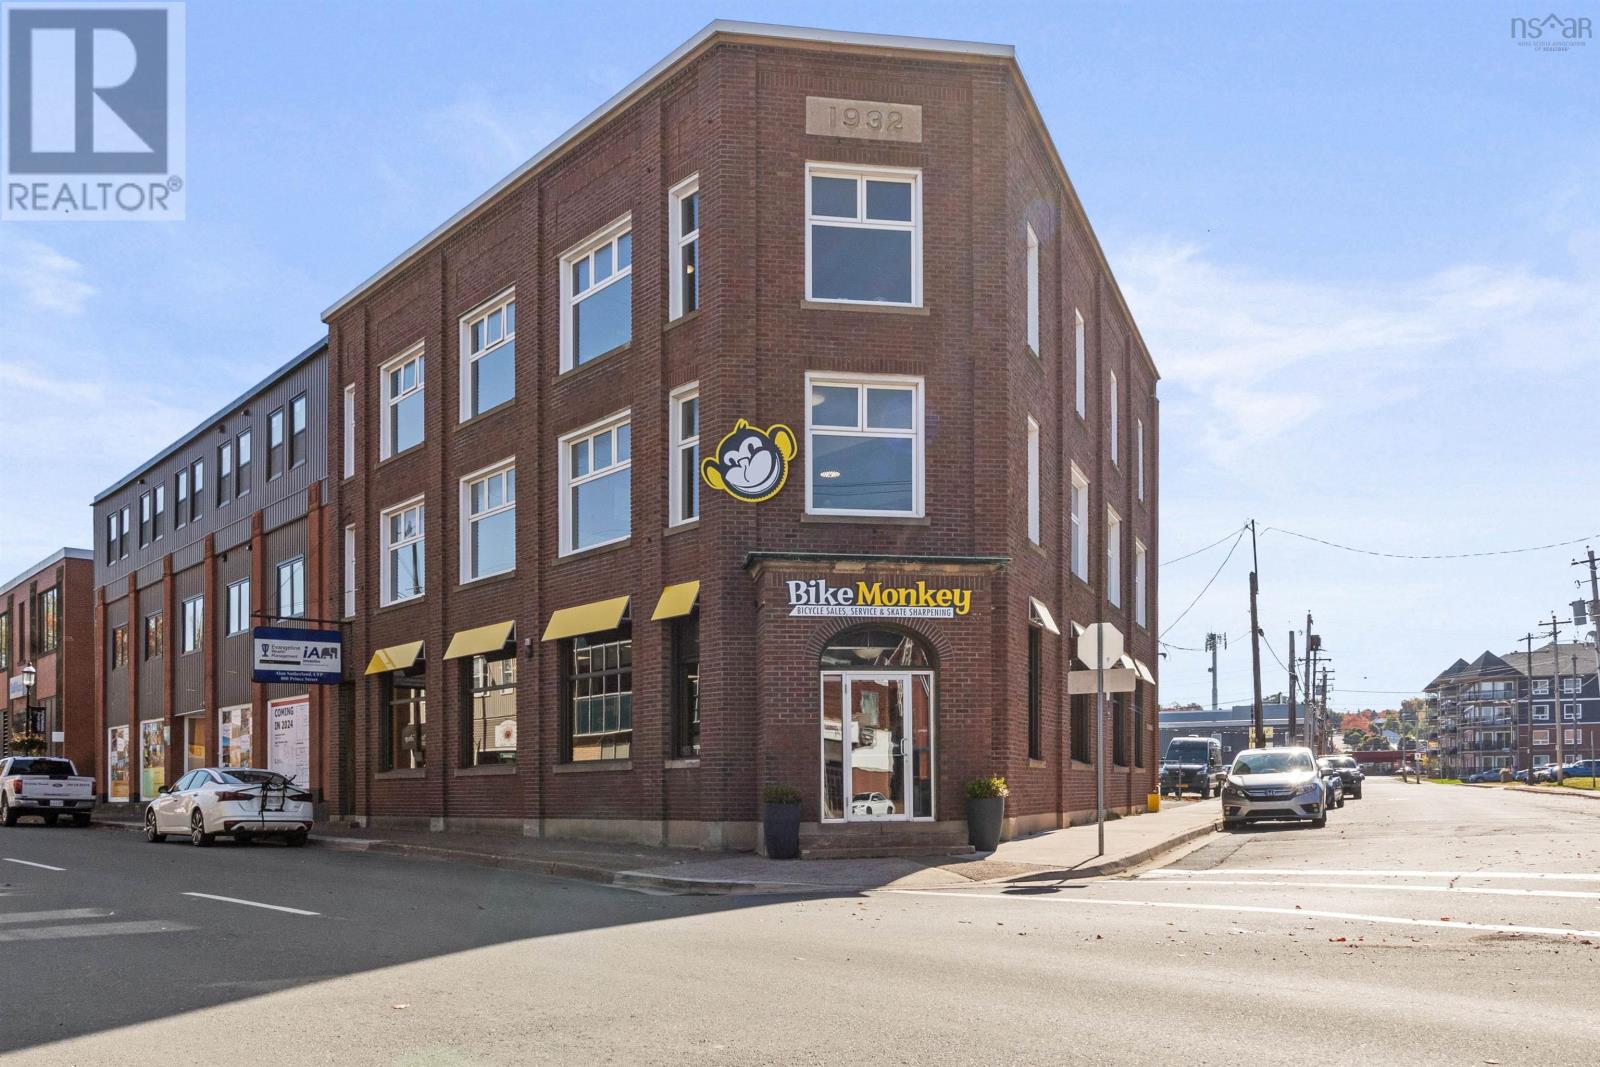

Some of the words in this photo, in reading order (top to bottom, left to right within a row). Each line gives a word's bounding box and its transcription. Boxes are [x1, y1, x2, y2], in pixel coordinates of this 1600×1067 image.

[829, 106, 904, 132] 1932
[786, 579, 854, 605] Bike
[856, 580, 973, 615] Monkey
[797, 606, 824, 615] BICYCLE
[826, 607, 847, 616] SALES,
[851, 607, 877, 616] SERVICE
[879, 608, 885, 616] &
[887, 608, 907, 616] SKATE
[909, 608, 952, 617] SHARPENING
[274, 706, 294, 718] COMING
[274, 722, 280, 730] IN
[282, 720, 294, 730] 2024
